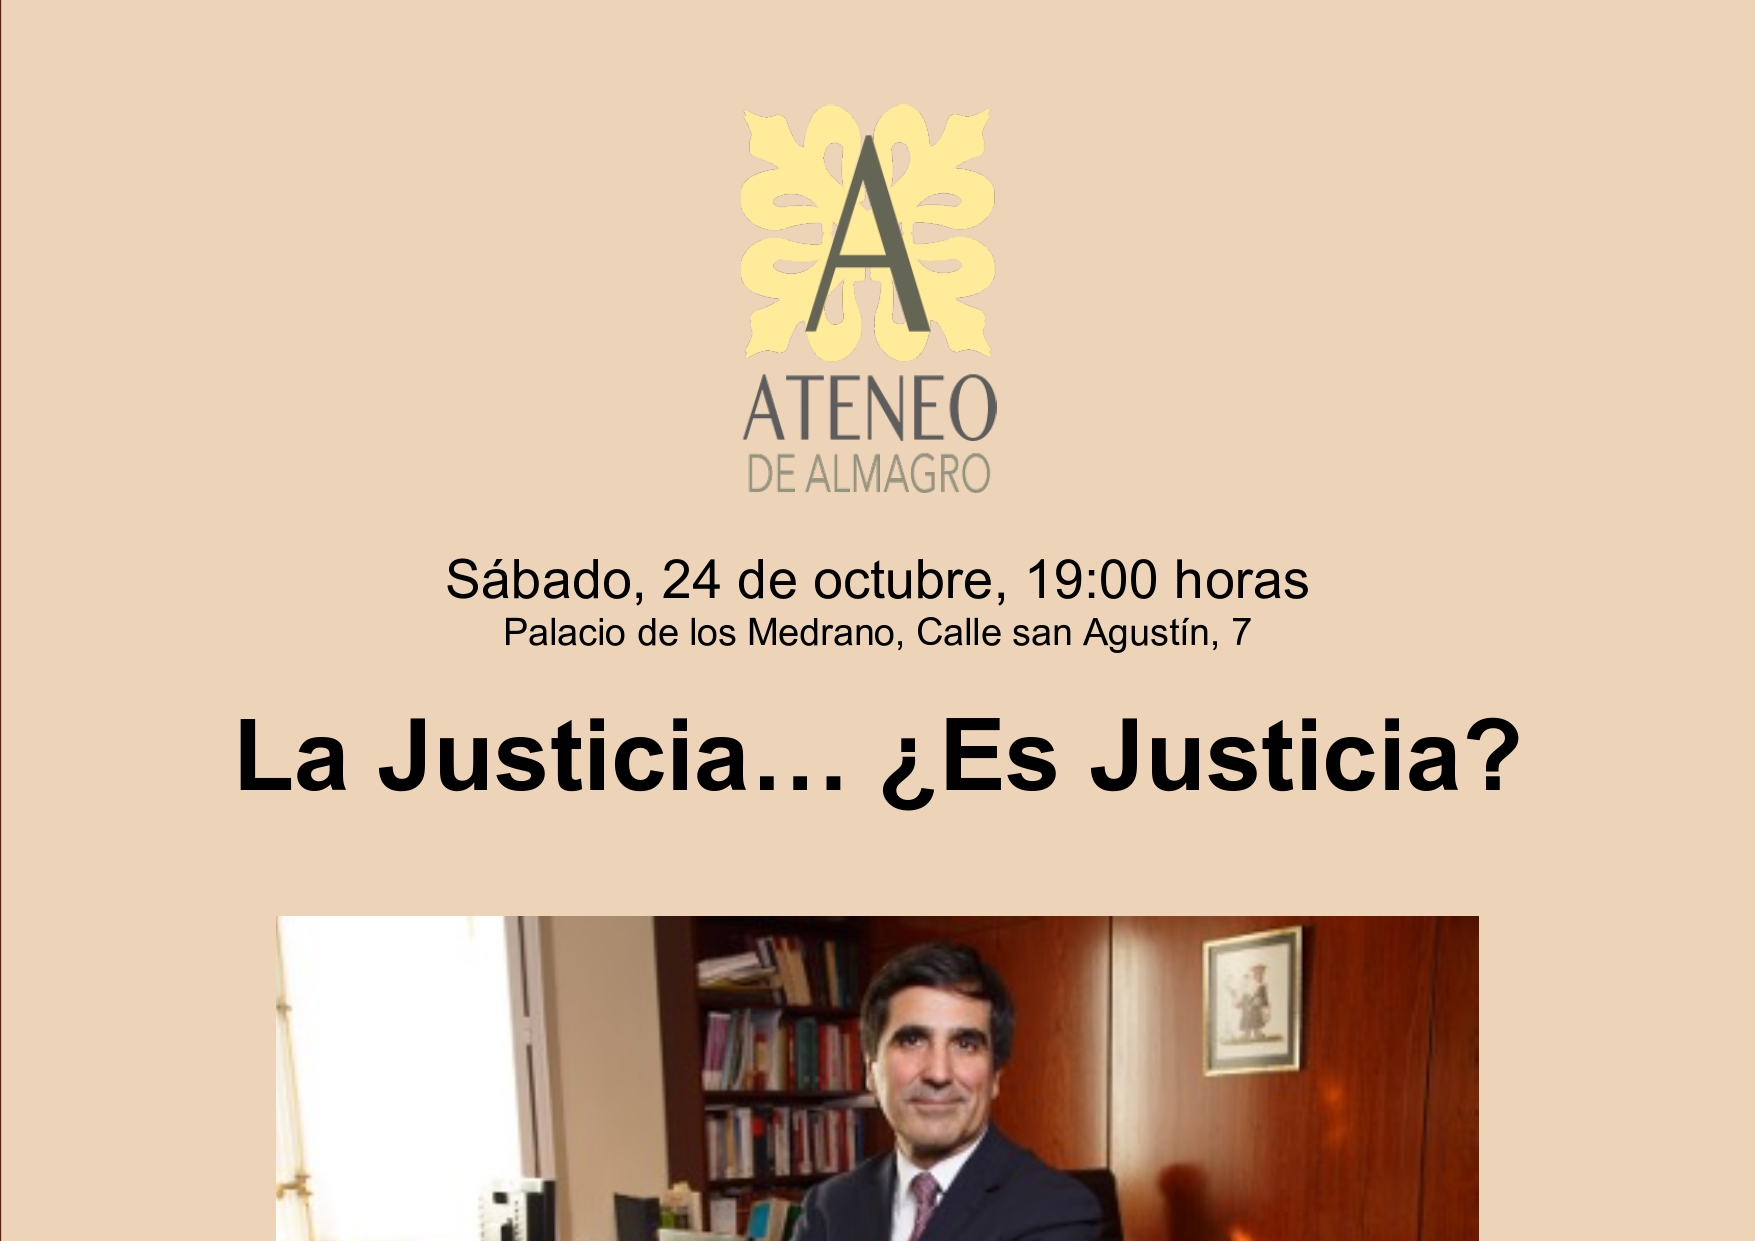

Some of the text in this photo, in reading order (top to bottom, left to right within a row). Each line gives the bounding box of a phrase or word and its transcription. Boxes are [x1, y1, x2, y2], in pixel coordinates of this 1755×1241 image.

[805, 135, 931, 332] A
[743, 374, 997, 441] ATENEO
[749, 453, 991, 493] DE ALMAGRO
[447, 558, 1308, 606] Sábado, 24 de octubre, 19:00 horas
[506, 617, 1251, 653] Palacio de los Medrano, Calle san Agustín, 7
[240, 719, 346, 791] La
[883, 718, 1056, 811] ¿Es
[1091, 717, 1519, 791] Justicia?
